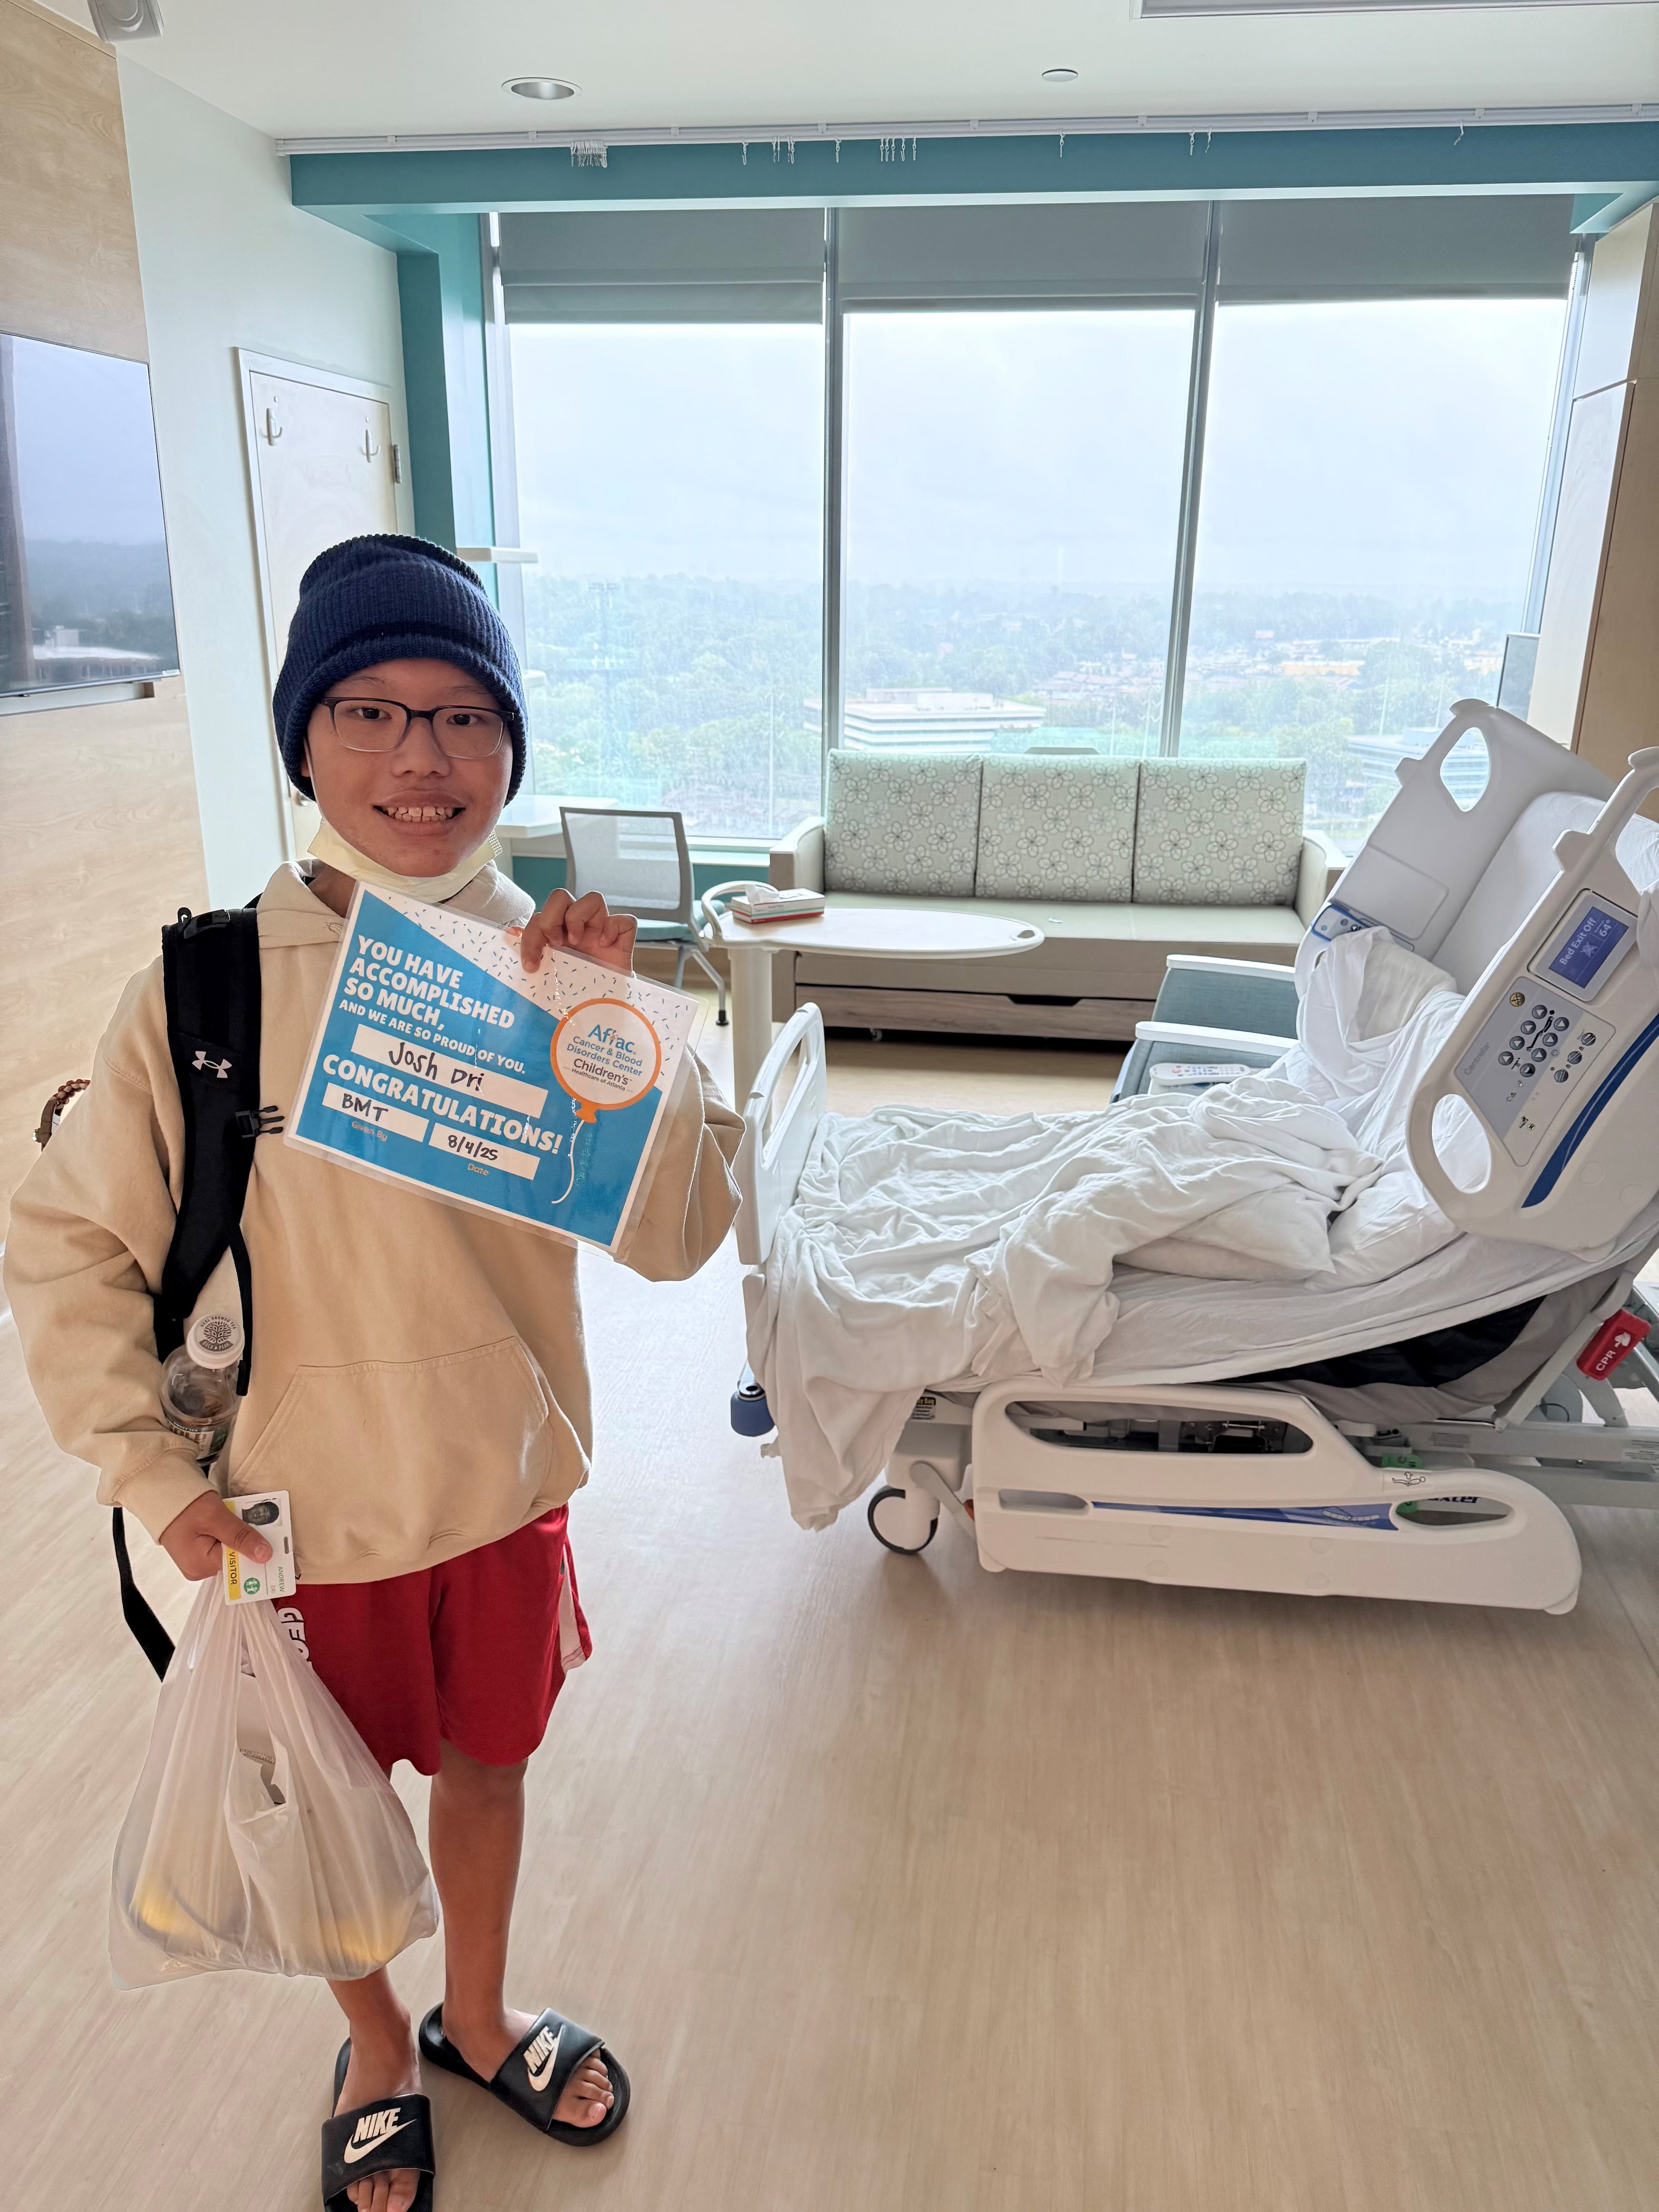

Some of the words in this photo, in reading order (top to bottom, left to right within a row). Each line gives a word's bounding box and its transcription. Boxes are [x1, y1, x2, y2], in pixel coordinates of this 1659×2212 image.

[1559, 947, 1575, 965] Bed
[1571, 932, 1587, 948] Exit
[1583, 917, 1596, 931] Off
[358, 935, 403, 966] YOU
[404, 953, 463, 989] HAVE
[344, 978, 374, 1001] SO
[376, 988, 445, 1031] MUCH,
[349, 958, 515, 1028] ACCOMPLISHED
[339, 1000, 365, 1016] AND
[368, 1009, 387, 1024] WE
[388, 1017, 412, 1034] ARE
[414, 1027, 431, 1041] SO
[432, 1033, 476, 1056] PROUD
[477, 1049, 496, 1062] OF
[497, 1056, 526, 1074] YOU.
[573, 1036, 604, 1052] Cancer
[616, 1052, 643, 1067] Blood
[388, 1042, 437, 1080] Josh
[567, 1043, 610, 1065] Disorders
[613, 1061, 643, 1076] Center
[572, 1068, 600, 1081] Healthcare
[607, 1081, 625, 1091] Atlanta
[323, 1054, 563, 1154] CONGRATULATIONS!
[342, 1093, 388, 1122] BMT
[377, 1130, 388, 1142] By
[448, 1135, 498, 1160] 8/4/25
[467, 1163, 489, 1176] Date
[1596, 1350, 1616, 1371] CPR
[229, 1551, 237, 1585] VISITOR
[524, 2025, 557, 2074] NIKE
[353, 2107, 401, 2143] NIKE
